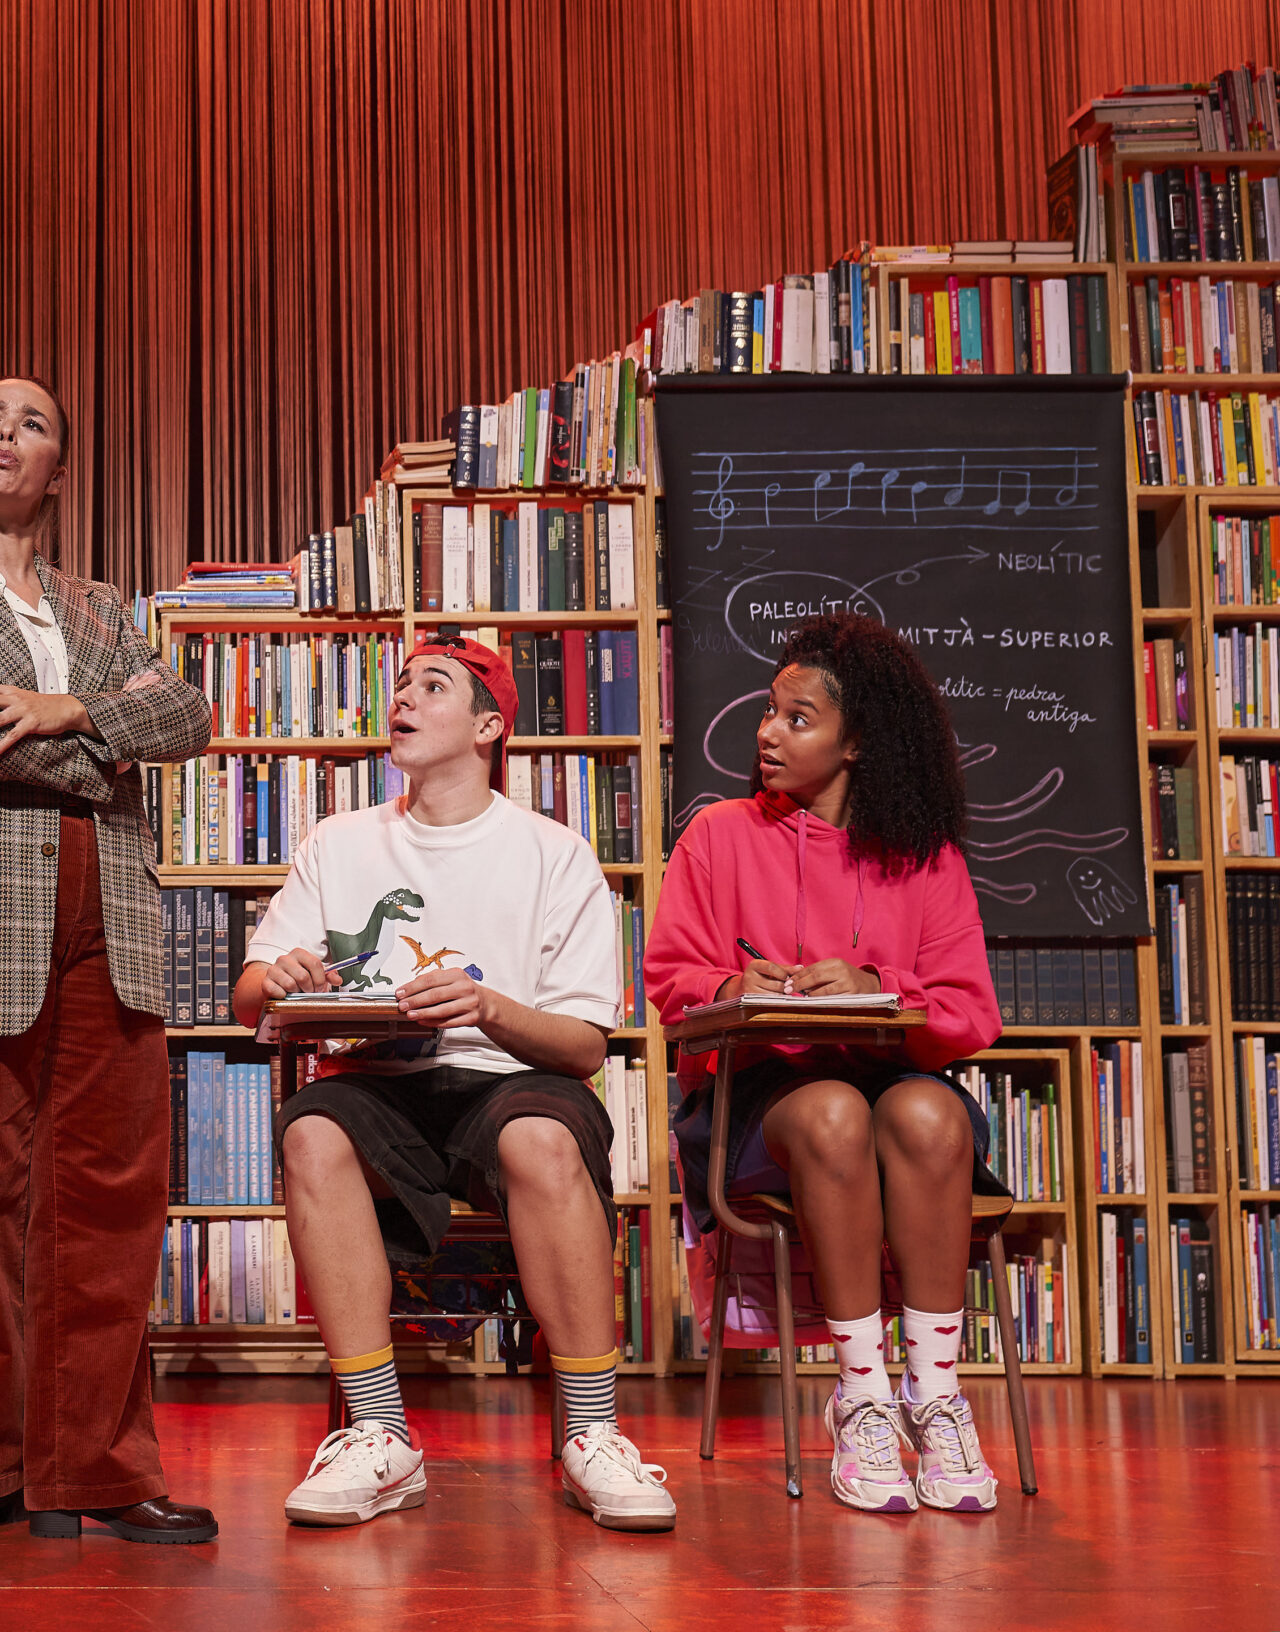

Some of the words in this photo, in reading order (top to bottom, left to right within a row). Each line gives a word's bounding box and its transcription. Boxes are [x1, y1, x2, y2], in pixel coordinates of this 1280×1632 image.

[999, 541, 1102, 572] NEOLÍTIC
[749, 595, 868, 621] PALEOLÍTIC
[999, 629, 1113, 649] SUPERIOR
[1005, 684, 1066, 712] pedra
[1027, 703, 1097, 733] antiga
